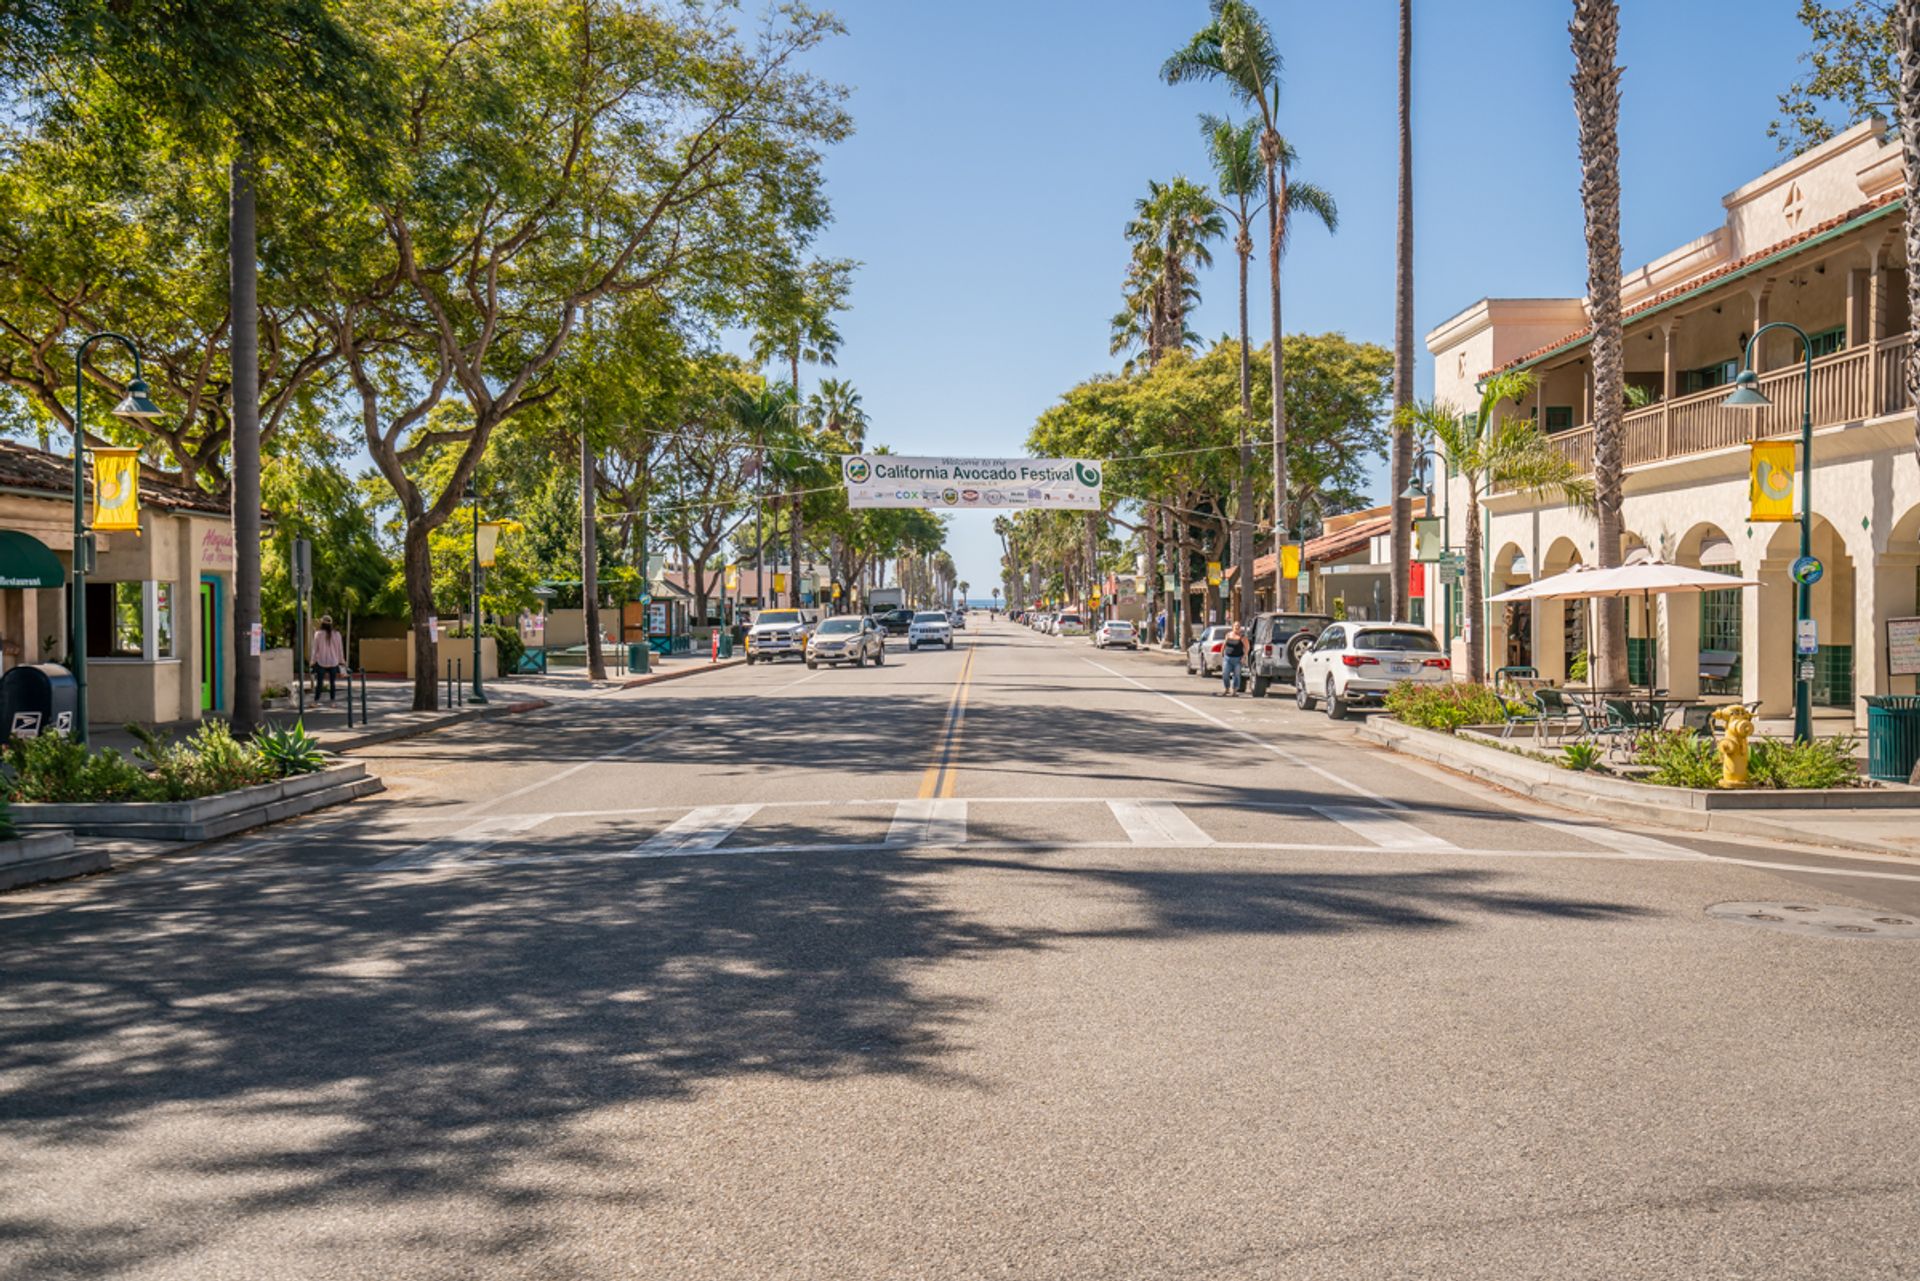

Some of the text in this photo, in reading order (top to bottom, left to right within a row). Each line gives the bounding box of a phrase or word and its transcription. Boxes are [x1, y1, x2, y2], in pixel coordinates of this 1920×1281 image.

[941, 457, 1006, 467] Welcome to the
[875, 464, 948, 480] California
[953, 466, 1017, 480] Avocado
[1020, 467, 1074, 481] Festival
